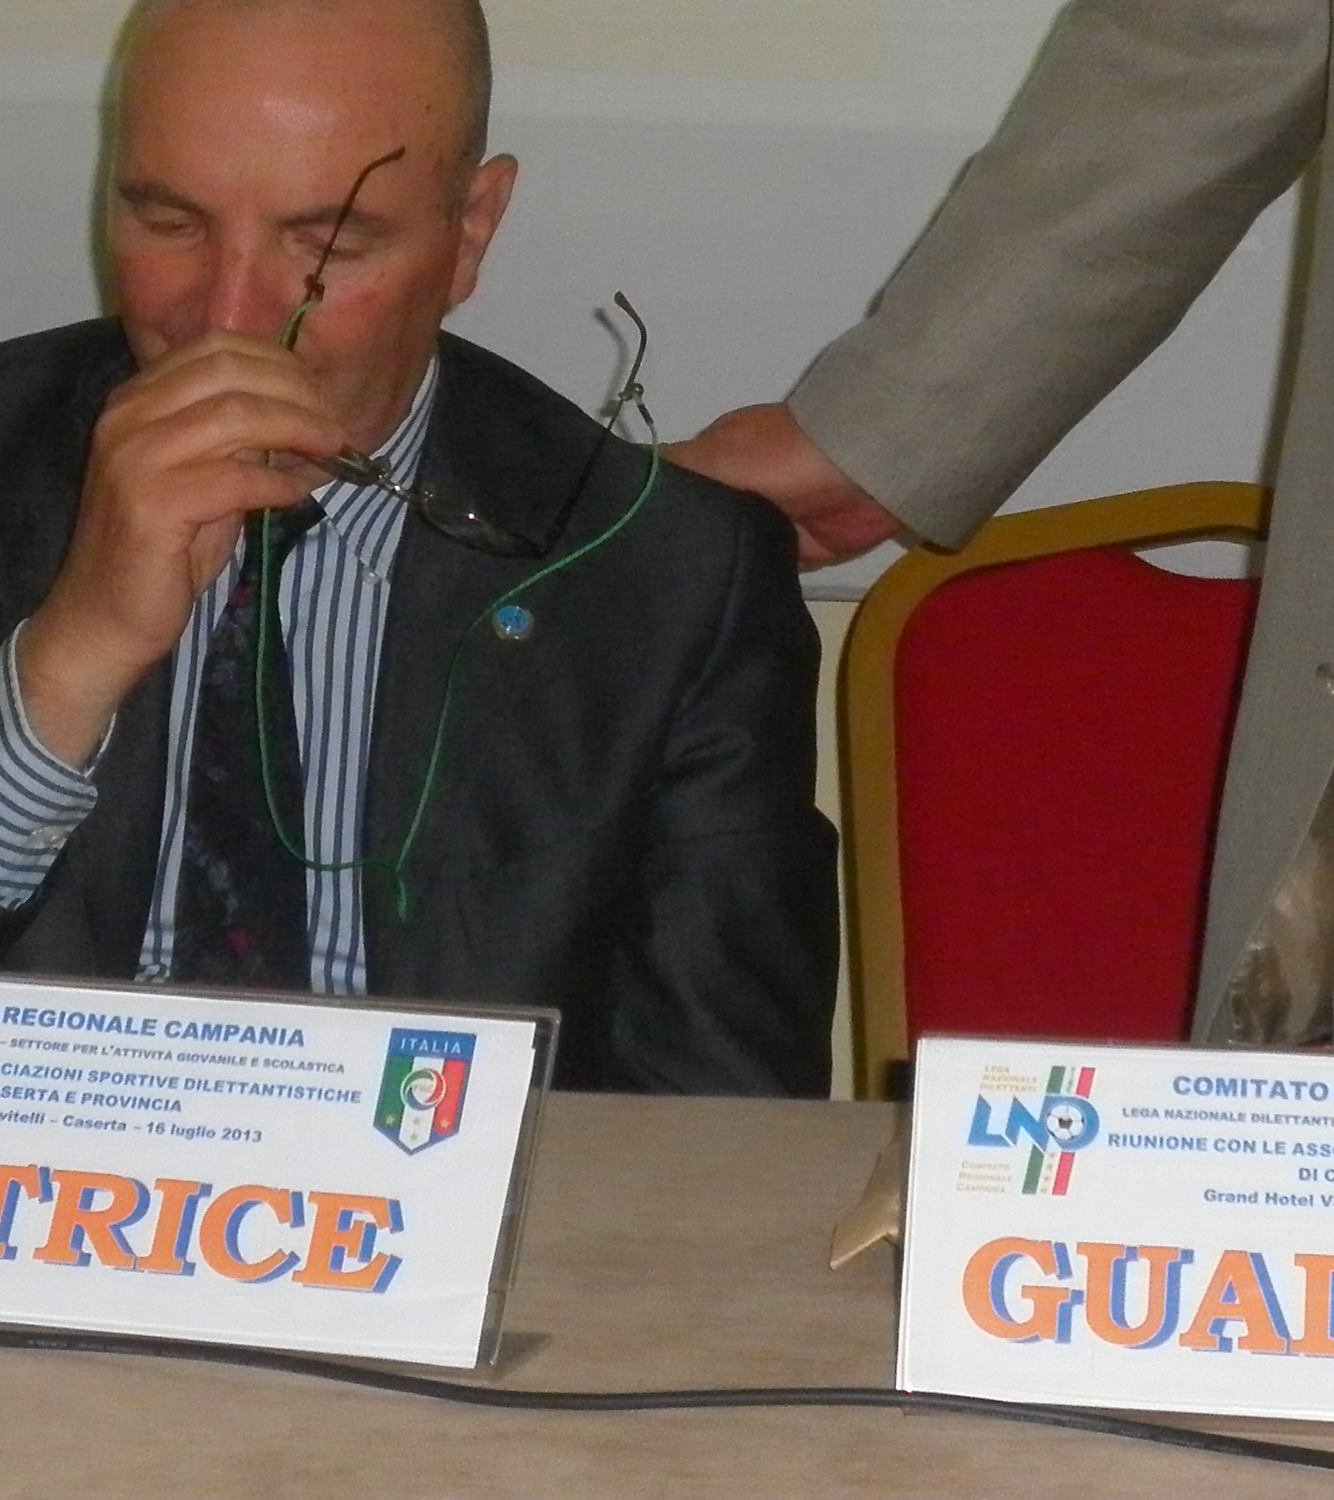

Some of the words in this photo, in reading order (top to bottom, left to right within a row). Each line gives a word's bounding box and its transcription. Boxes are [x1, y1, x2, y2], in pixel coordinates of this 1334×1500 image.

[2, 1004, 158, 1037] REGIONALE
[163, 1019, 305, 1047] CAMPANIA
[9, 1038, 69, 1053] SETTORE
[72, 1044, 98, 1056] PER
[101, 1044, 173, 1061] L'ATTIVITÀ
[176, 1052, 248, 1067] GIOVANILE
[250, 1057, 260, 1067] E
[262, 1058, 345, 1074] SCOLASTICA
[400, 1038, 462, 1054] ITALIA
[87, 1069, 179, 1090] SPORTIVE
[183, 1077, 362, 1104] DILETTANTISTICHE
[1172, 1075, 1329, 1102] COMITATO
[64, 1091, 76, 1104] E
[80, 1092, 182, 1113] PROVINCIA
[62, 1114, 127, 1133] Caserta
[146, 1121, 166, 1135] 16
[170, 1123, 216, 1141] luglio
[221, 1127, 263, 1143] 2013
[967, 1093, 1100, 1152] LND
[1121, 1107, 1160, 1119] LEGA
[1164, 1108, 1247, 1123] NAZIONALE
[1251, 1113, 1334, 1127] DILETTANTI
[1108, 1133, 1208, 1152] RIUNIONE
[1213, 1138, 1257, 1154] CON
[1262, 1140, 1286, 1156] LE
[1298, 1167, 1318, 1182] DI
[1203, 1188, 1259, 1204] Grand
[1264, 1191, 1314, 1207] Hotel
